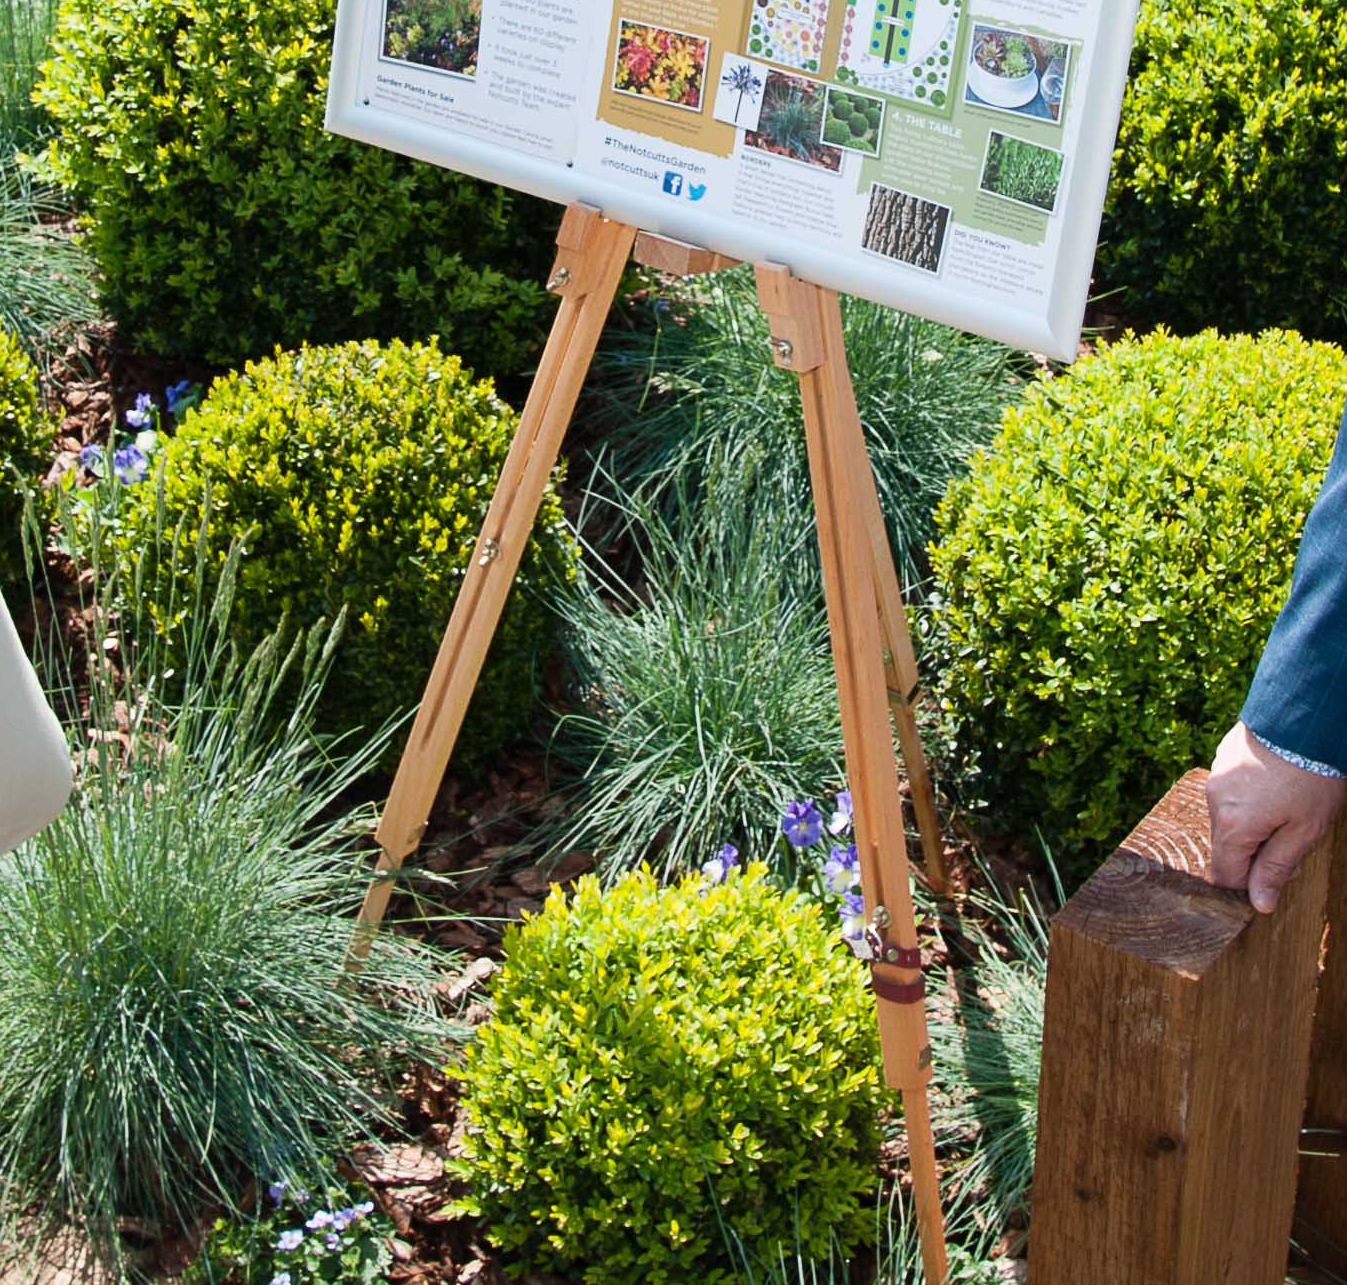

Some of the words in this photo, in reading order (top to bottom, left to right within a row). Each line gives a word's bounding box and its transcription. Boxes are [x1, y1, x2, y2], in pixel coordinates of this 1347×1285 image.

[376, 74, 402, 88] Garden
[404, 82, 425, 95] Plants
[427, 89, 437, 99] for
[439, 92, 453, 104] Sale
[905, 113, 925, 128] THE
[927, 120, 962, 139] TABLE
[601, 155, 658, 181] @notcuttsuk
[604, 136, 707, 176] #TheNotcuttsGarden
[968, 233, 983, 243] YOU
[984, 237, 1011, 251] KNOW?
